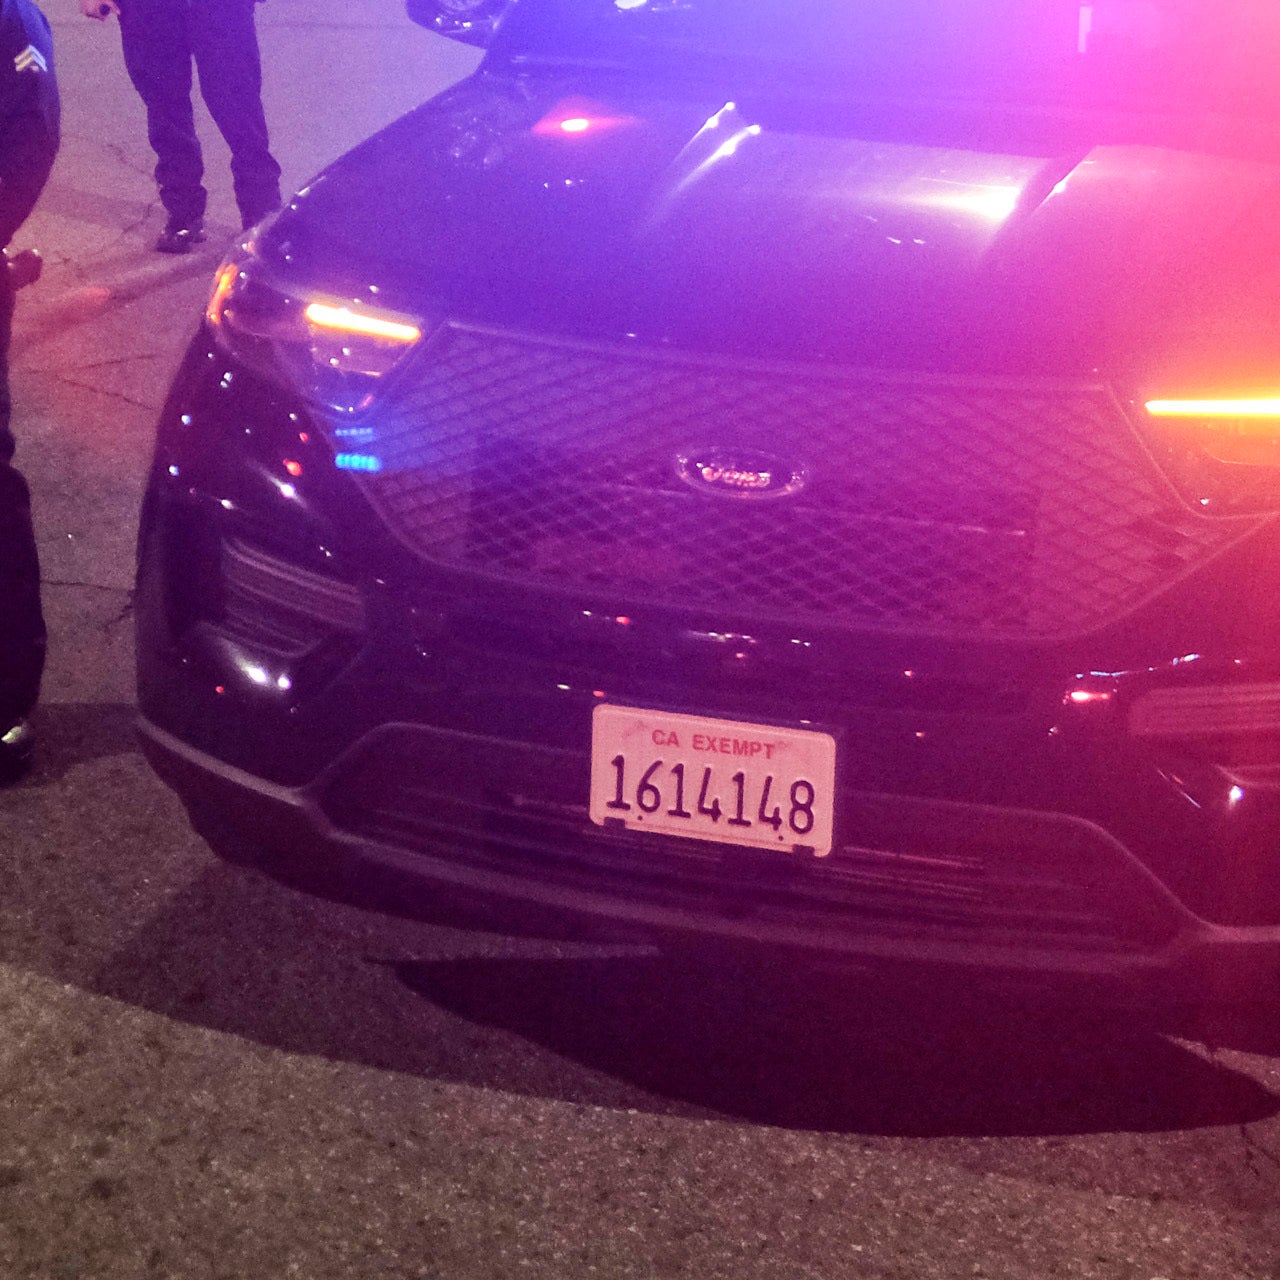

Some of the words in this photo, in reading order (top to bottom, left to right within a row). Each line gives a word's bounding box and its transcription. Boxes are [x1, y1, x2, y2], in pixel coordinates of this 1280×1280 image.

[651, 729, 680, 748] CA
[692, 733, 776, 760] EXEMPT
[606, 754, 815, 835] 1614148
